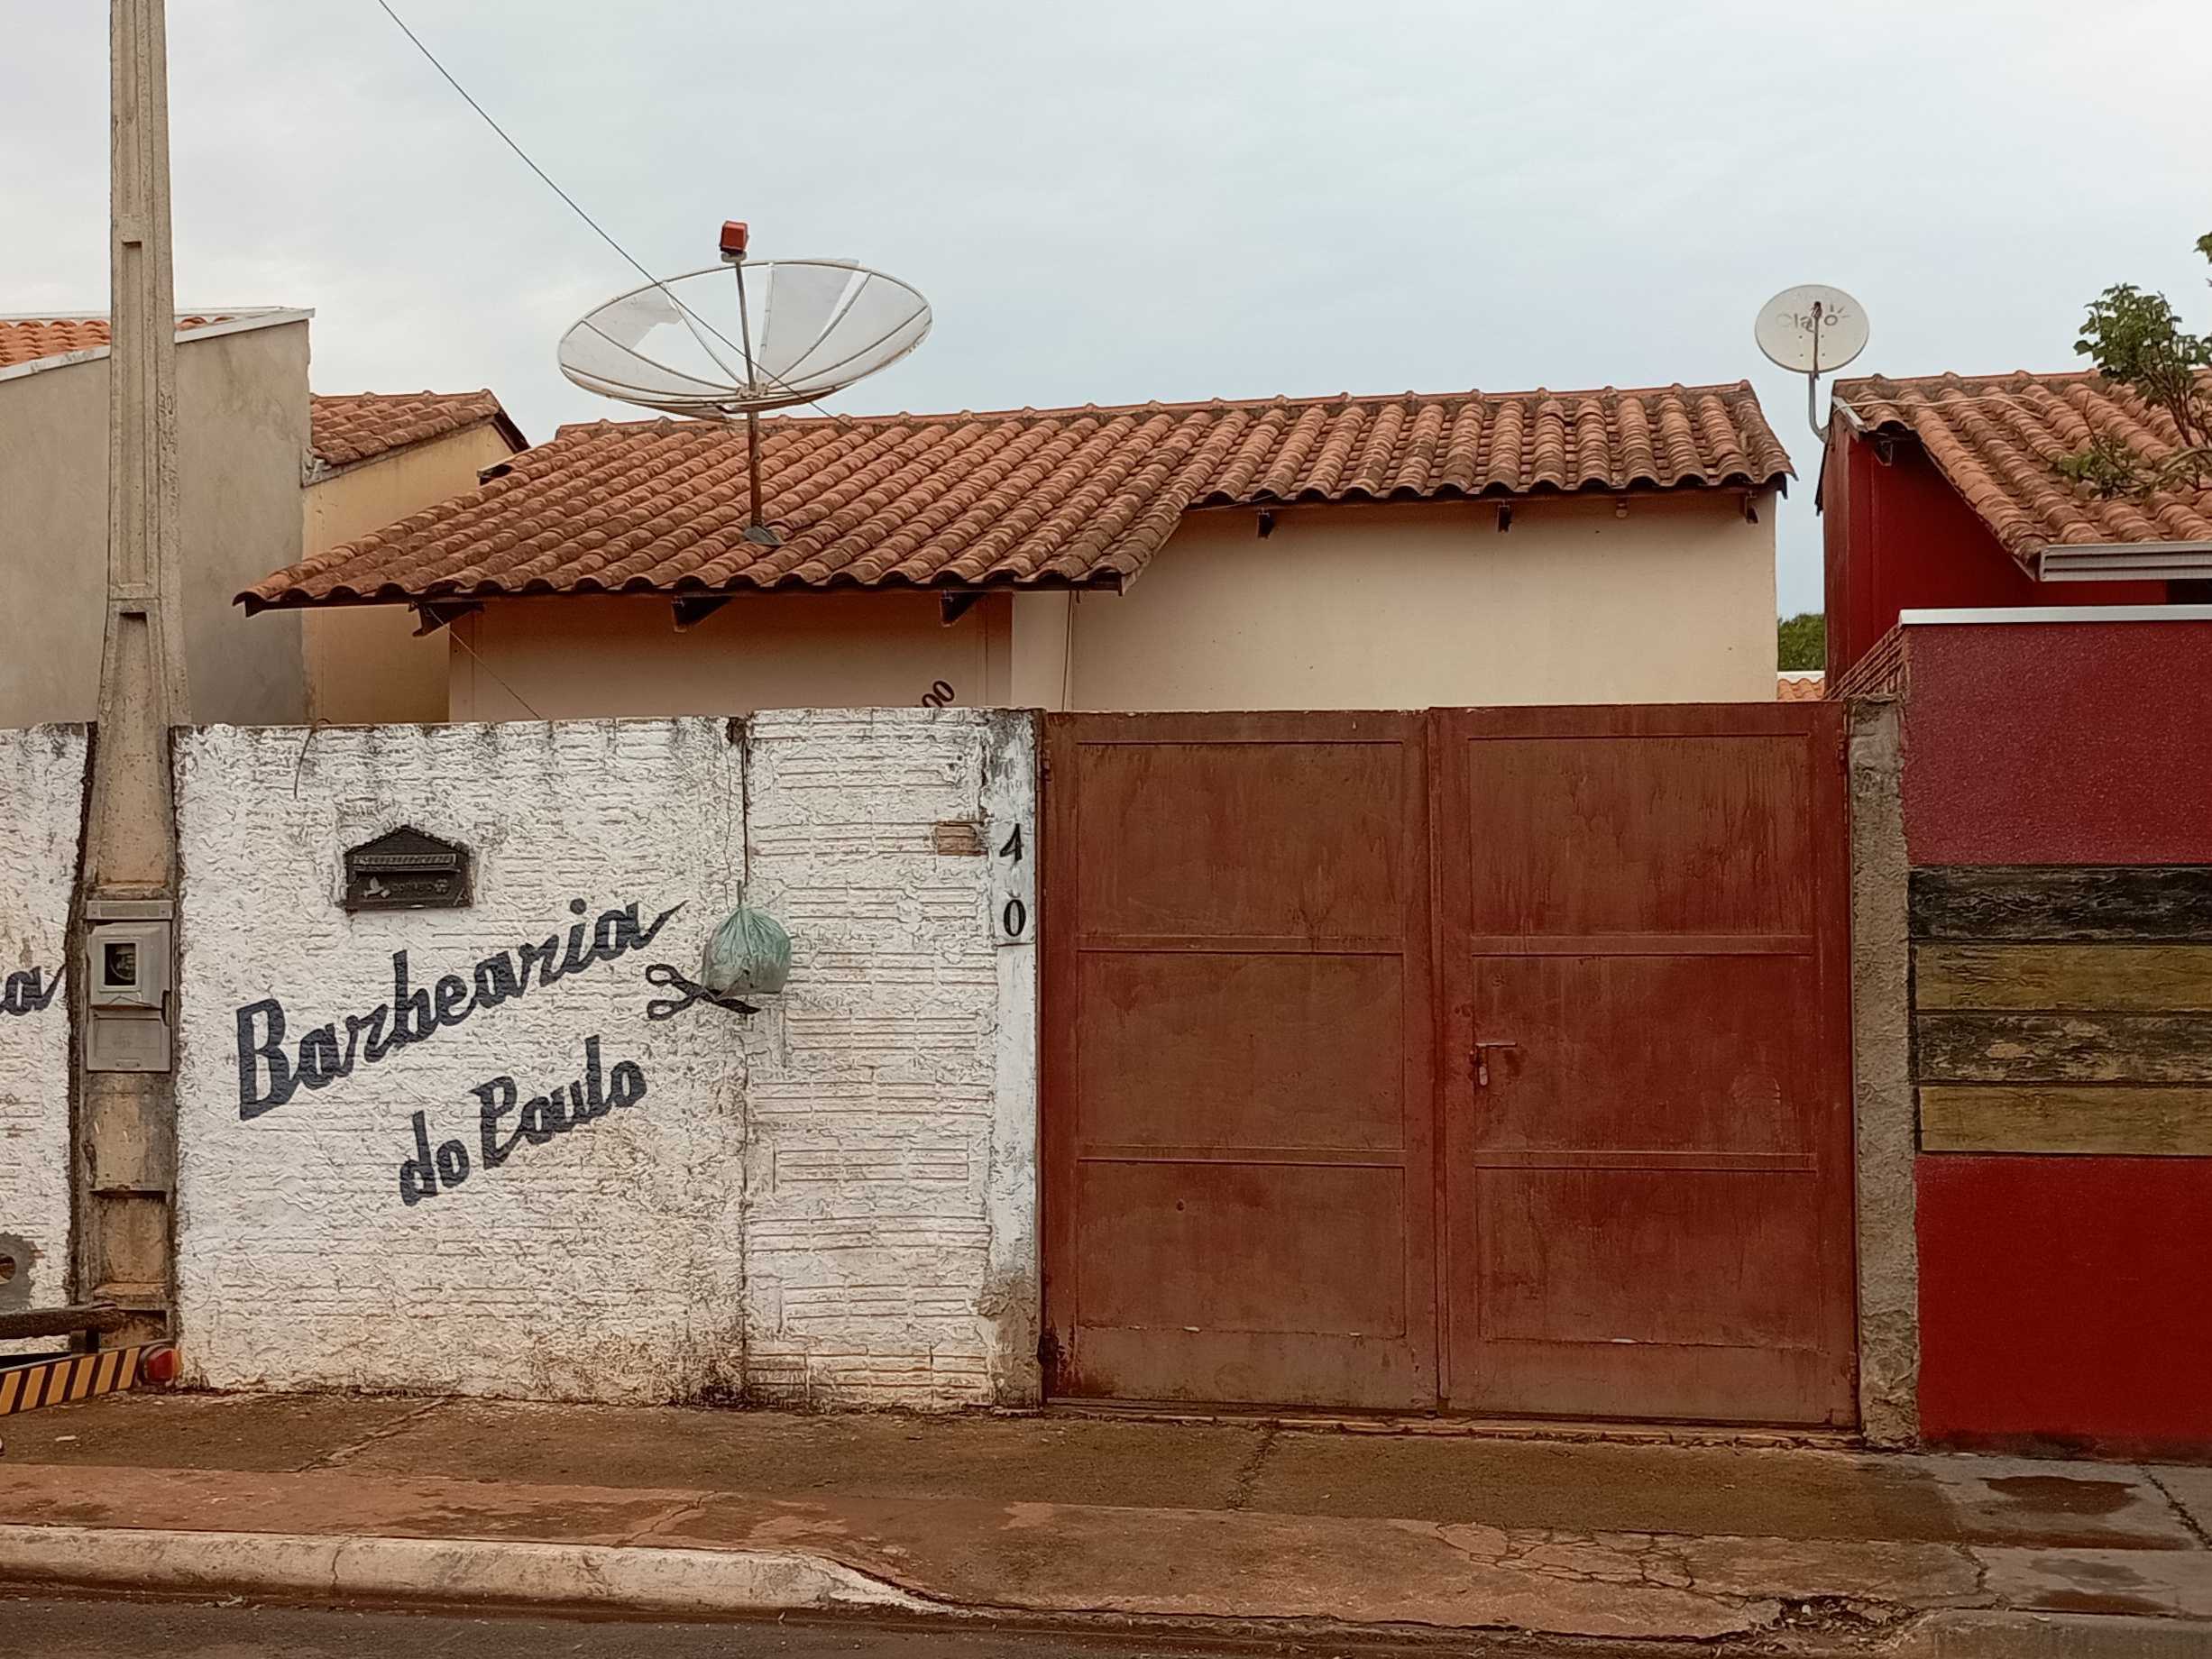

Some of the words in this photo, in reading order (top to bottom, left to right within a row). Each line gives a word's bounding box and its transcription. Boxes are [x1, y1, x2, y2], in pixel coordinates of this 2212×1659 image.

[236, 898, 689, 1121] Barbearia
[399, 1110, 470, 1206] do
[467, 1034, 647, 1169] Paulo
